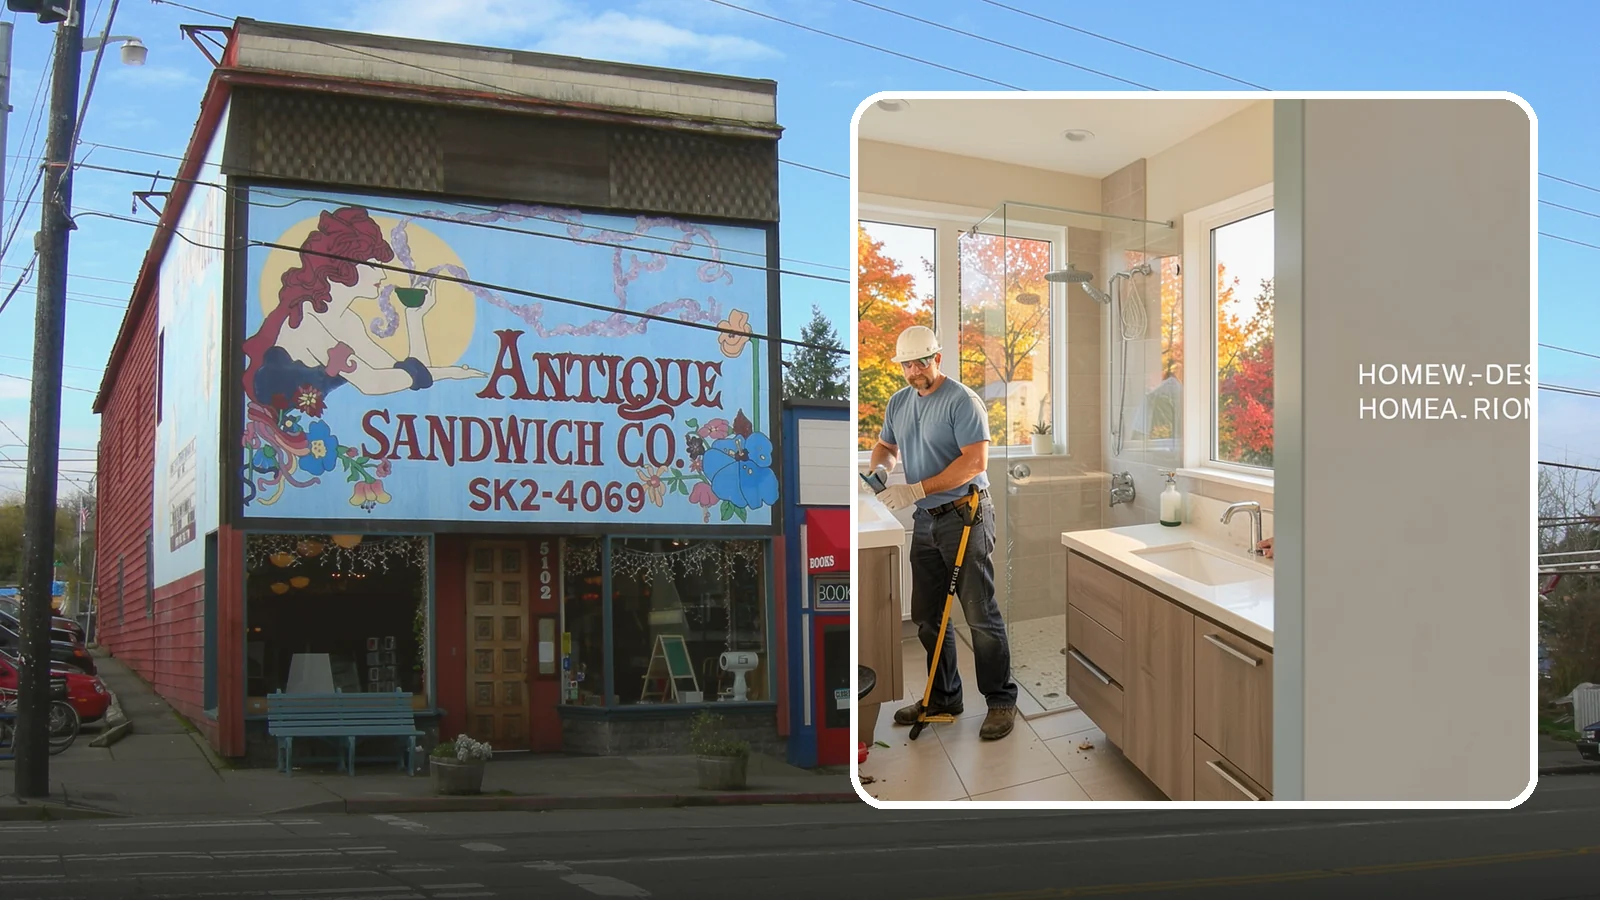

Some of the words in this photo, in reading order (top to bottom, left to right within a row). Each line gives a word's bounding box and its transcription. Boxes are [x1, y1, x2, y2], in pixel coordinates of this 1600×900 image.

[476, 328, 724, 421] ANTIQUE
[360, 408, 605, 467] SANDWICH
[617, 421, 685, 469] CO.
[468, 477, 646, 514] SK2-4069
[539, 541, 552, 600] 5102
[809, 555, 835, 569] BOOKS
